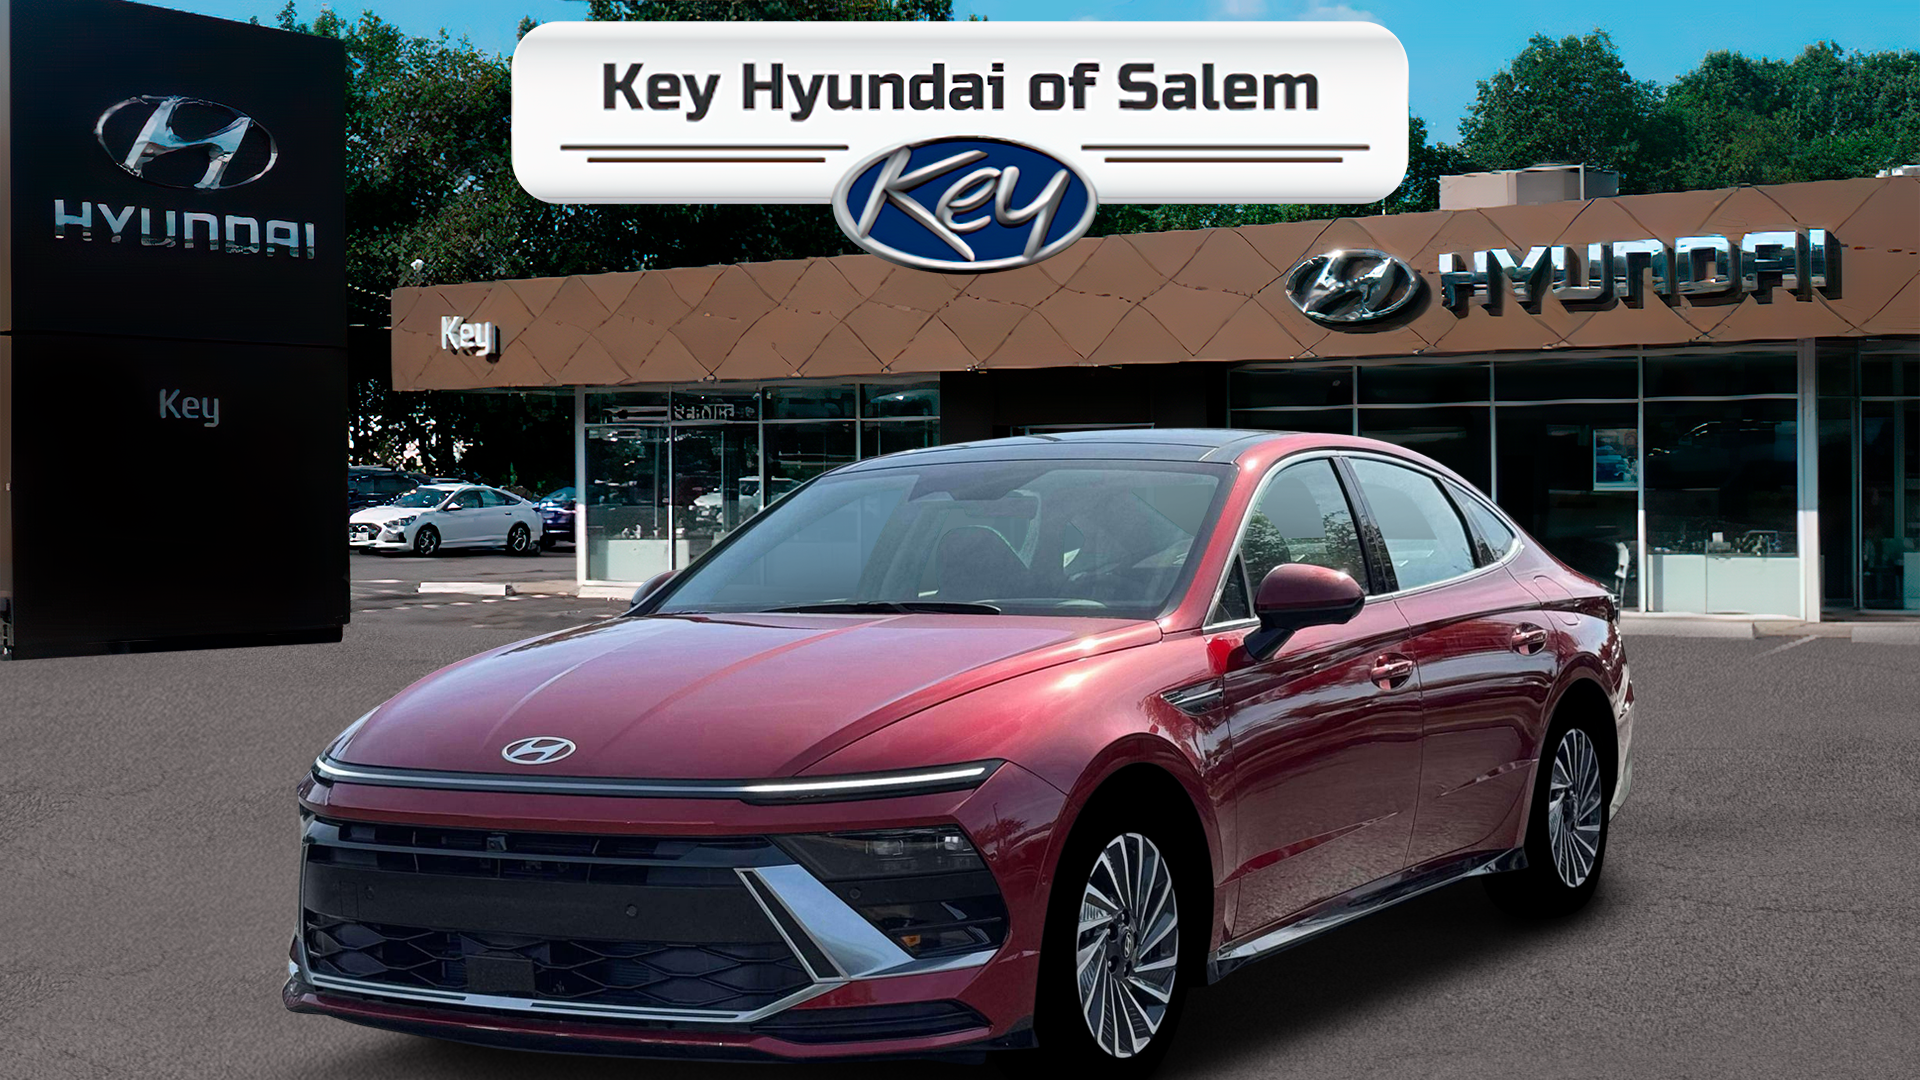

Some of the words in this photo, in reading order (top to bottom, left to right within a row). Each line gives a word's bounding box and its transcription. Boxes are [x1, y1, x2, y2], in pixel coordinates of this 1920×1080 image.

[54, 198, 315, 260] HYUNDAI
[1438, 229, 1838, 315] HYUNDAI
[440, 315, 495, 357] Key
[159, 388, 220, 428] Key
